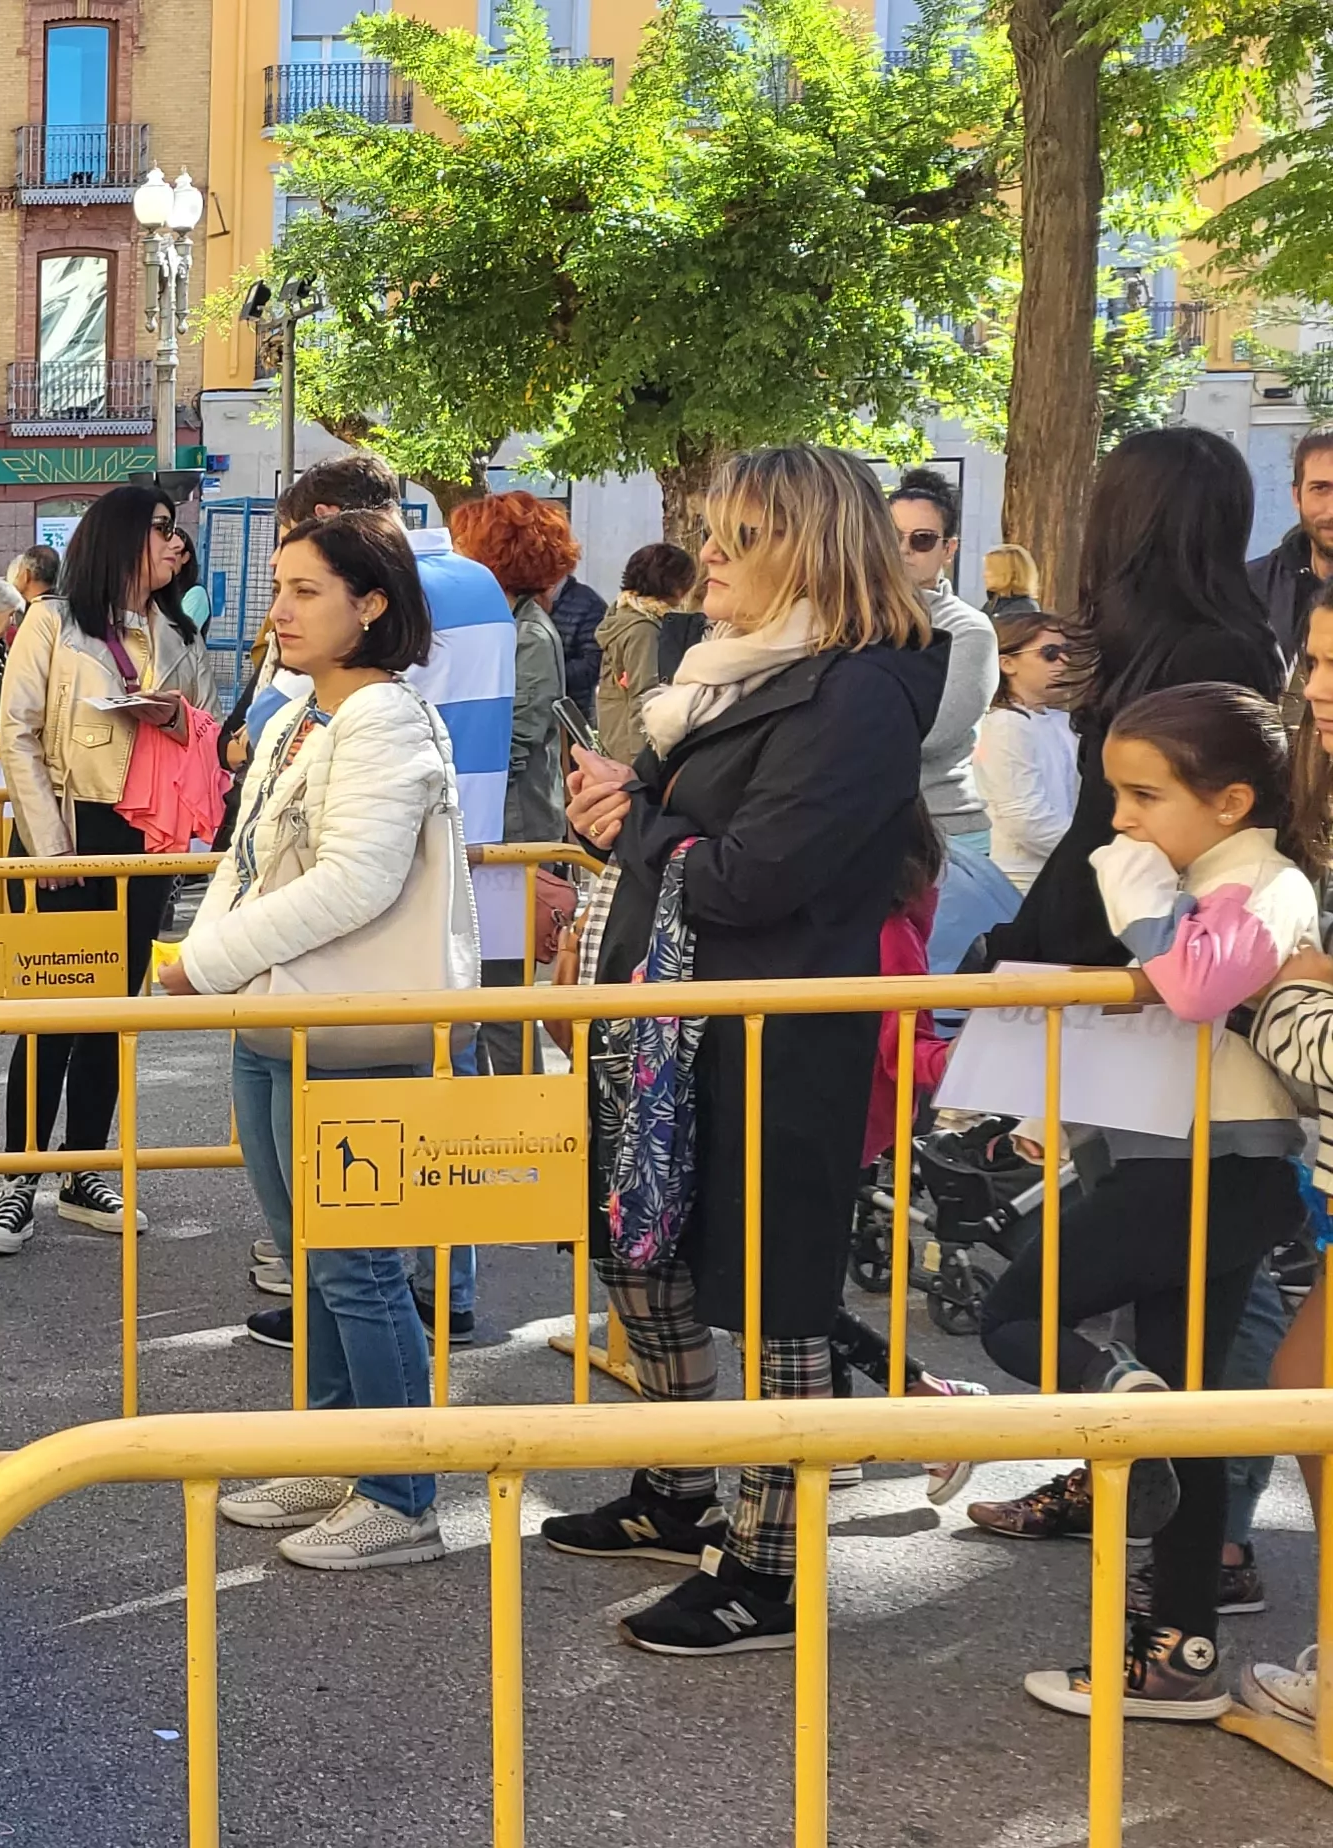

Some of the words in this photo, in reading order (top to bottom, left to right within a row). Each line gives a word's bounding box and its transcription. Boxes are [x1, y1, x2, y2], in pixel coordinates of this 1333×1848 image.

[13, 949, 119, 970] Ayuntamiento
[12, 972, 31, 985] de
[36, 971, 95, 985] Huesca
[412, 1131, 578, 1161] Ayuntamiento
[413, 1165, 441, 1186] de
[449, 1164, 539, 1186] Huesca
